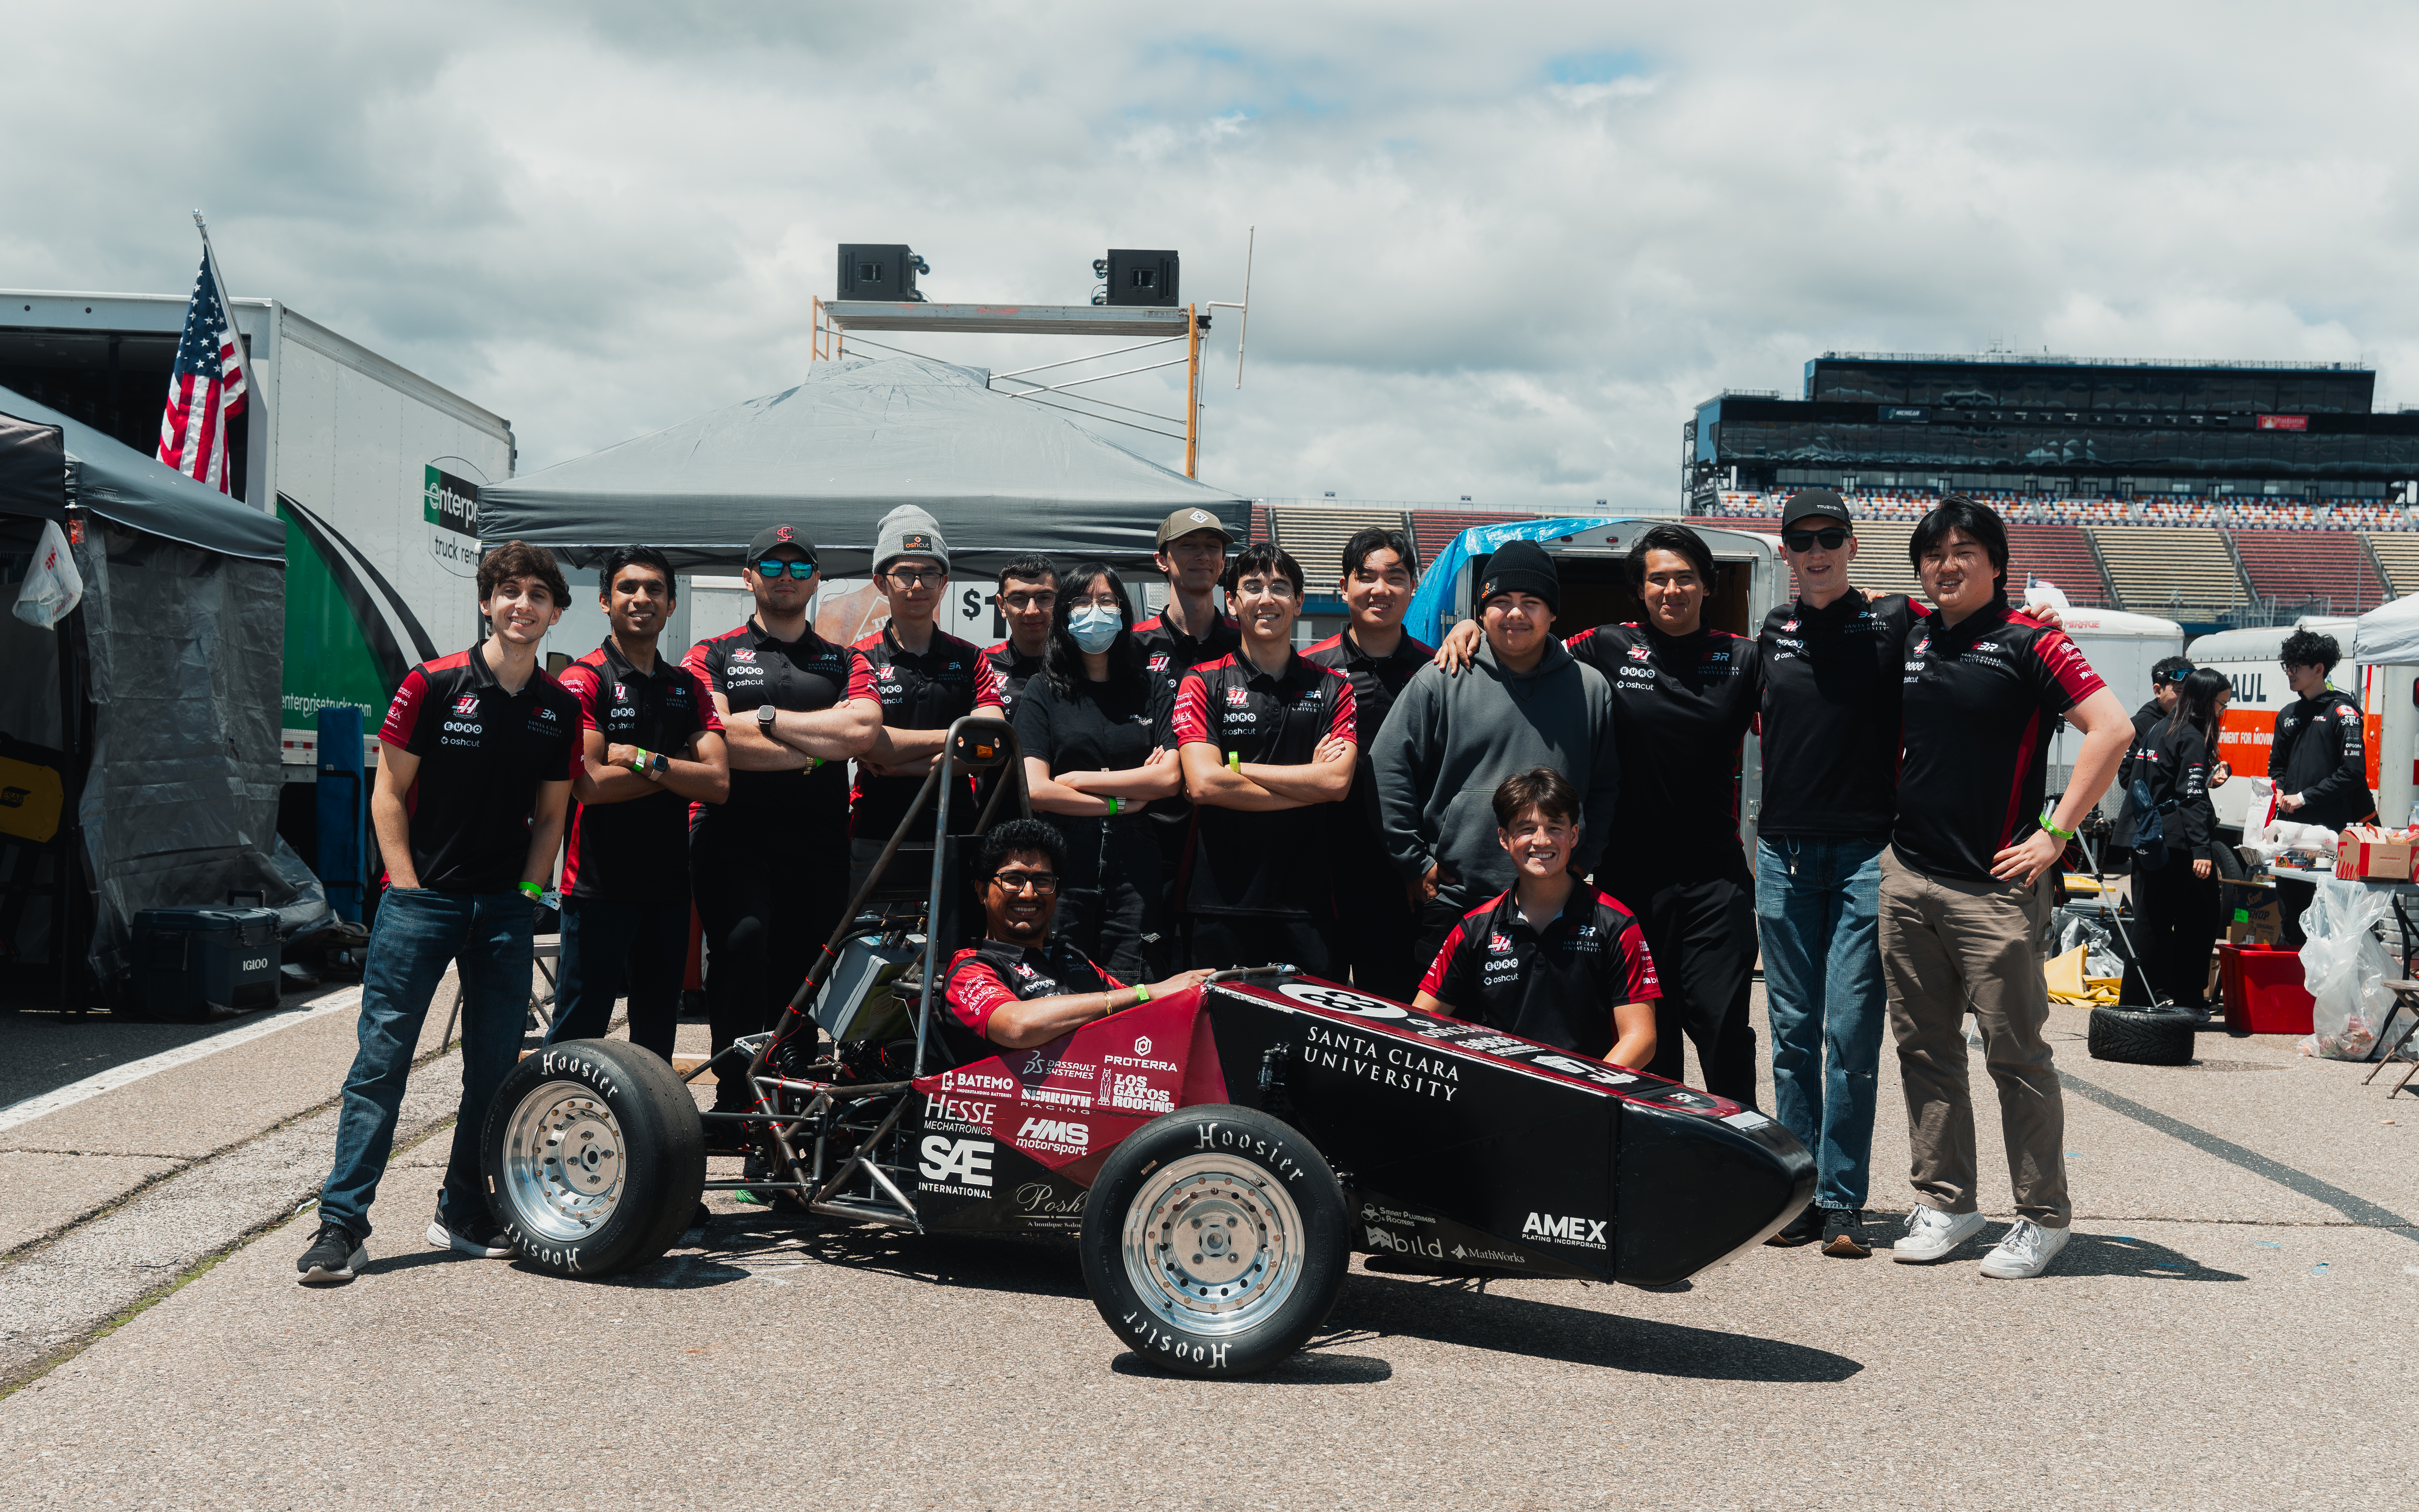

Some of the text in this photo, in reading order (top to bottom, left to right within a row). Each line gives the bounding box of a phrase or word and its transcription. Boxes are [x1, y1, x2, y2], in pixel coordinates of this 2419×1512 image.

[435, 536, 478, 567] truck rent
[1482, 585, 1495, 599] oshcut
[2064, 621, 2101, 629] MIRAGE
[1960, 657, 2001, 666] UNIVERSITY
[727, 666, 763, 675] EURO
[1620, 666, 1655, 678] EURO
[879, 685, 902, 693] URO
[1626, 682, 1654, 690] oshcut
[611, 708, 635, 717] ERO
[444, 722, 482, 734] EURO
[528, 720, 545, 728] SANTA
[450, 738, 480, 747] oshcut
[2240, 732, 2252, 744] FOR
[2253, 732, 2274, 745] MOVIN
[1, 791, 24, 803] ESAB
[2246, 891, 2263, 906] Scott
[2248, 909, 2270, 920] SHOP
[243, 958, 267, 971] IGLOO
[1485, 958, 1518, 971] EURO
[1493, 973, 1519, 983] oshcut
[1417, 1024, 1483, 1038] oshcut
[1308, 1026, 1459, 1081] SANTA CLARA
[1048, 1060, 1096, 1071] DASSAULT
[1104, 1055, 1178, 1072] PROTERRA
[541, 1051, 618, 1097] Hoosier
[1115, 1073, 1147, 1086] LOS
[1304, 1046, 1457, 1101] UNIVERSITY
[957, 1074, 1013, 1090] BATEMO
[1022, 1089, 1092, 1108] SCHROTH
[1113, 1083, 1170, 1102] GATOS
[925, 1093, 996, 1125] HESSE
[1020, 1102, 1090, 1115] RACING
[1112, 1097, 1175, 1113] ROOFING
[924, 1121, 992, 1136] MECHATRONICS
[1017, 1117, 1089, 1146] HMS
[1016, 1137, 1088, 1156] motorsport
[1195, 1122, 1303, 1180] Hoosier
[919, 1135, 994, 1186] SAE
[918, 1182, 992, 1199] INTERNATIONAL
[1016, 1183, 1088, 1212] Posh
[1380, 1206, 1435, 1224] SMART PLUMBERS
[1386, 1215, 1415, 1227] ROOTERS
[1522, 1212, 1607, 1244] AMEX
[504, 1223, 582, 1272] Hoosier
[1522, 1233, 1607, 1250] PLATING INCORPORATED
[1469, 1248, 1525, 1263] MathWorks
[1123, 1311, 1233, 1368] Hoosier
